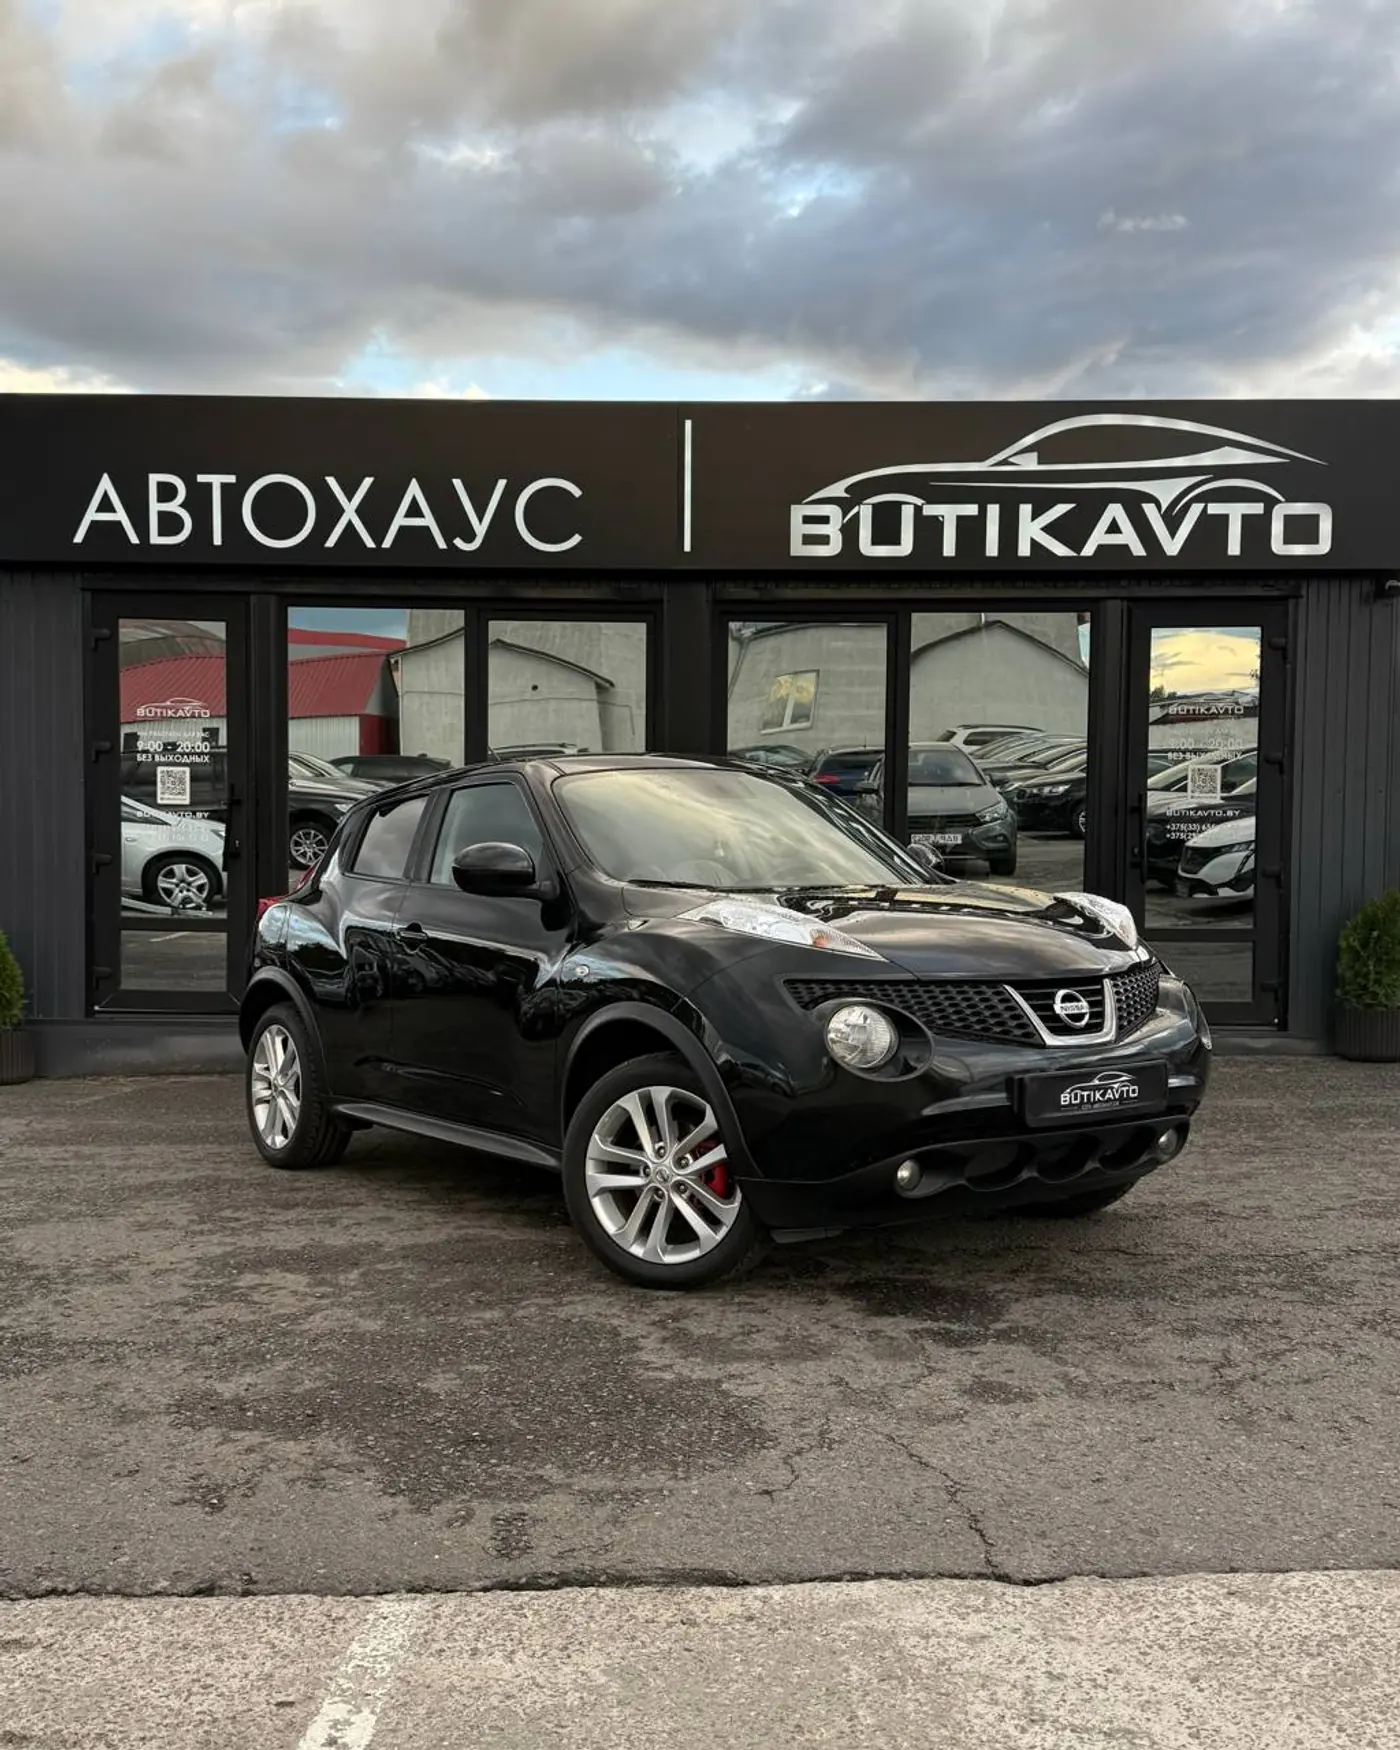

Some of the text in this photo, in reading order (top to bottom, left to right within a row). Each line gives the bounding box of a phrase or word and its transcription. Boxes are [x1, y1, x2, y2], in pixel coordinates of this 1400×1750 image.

[72, 471, 583, 552] АВТОХАУС
[789, 502, 1333, 557] BUTIKAVTO
[136, 708, 210, 718] BUTIKAVTO
[1168, 705, 1244, 715] BUTIKAVTO
[136, 741, 164, 752] 9:00
[176, 741, 210, 753] 20:00
[136, 753, 210, 763] БЕЗ ВЫХОДНЫХ
[1166, 809, 1241, 817] BUTIKAVTO.BY
[1060, 1085, 1139, 1105] BUTIKAVTO
